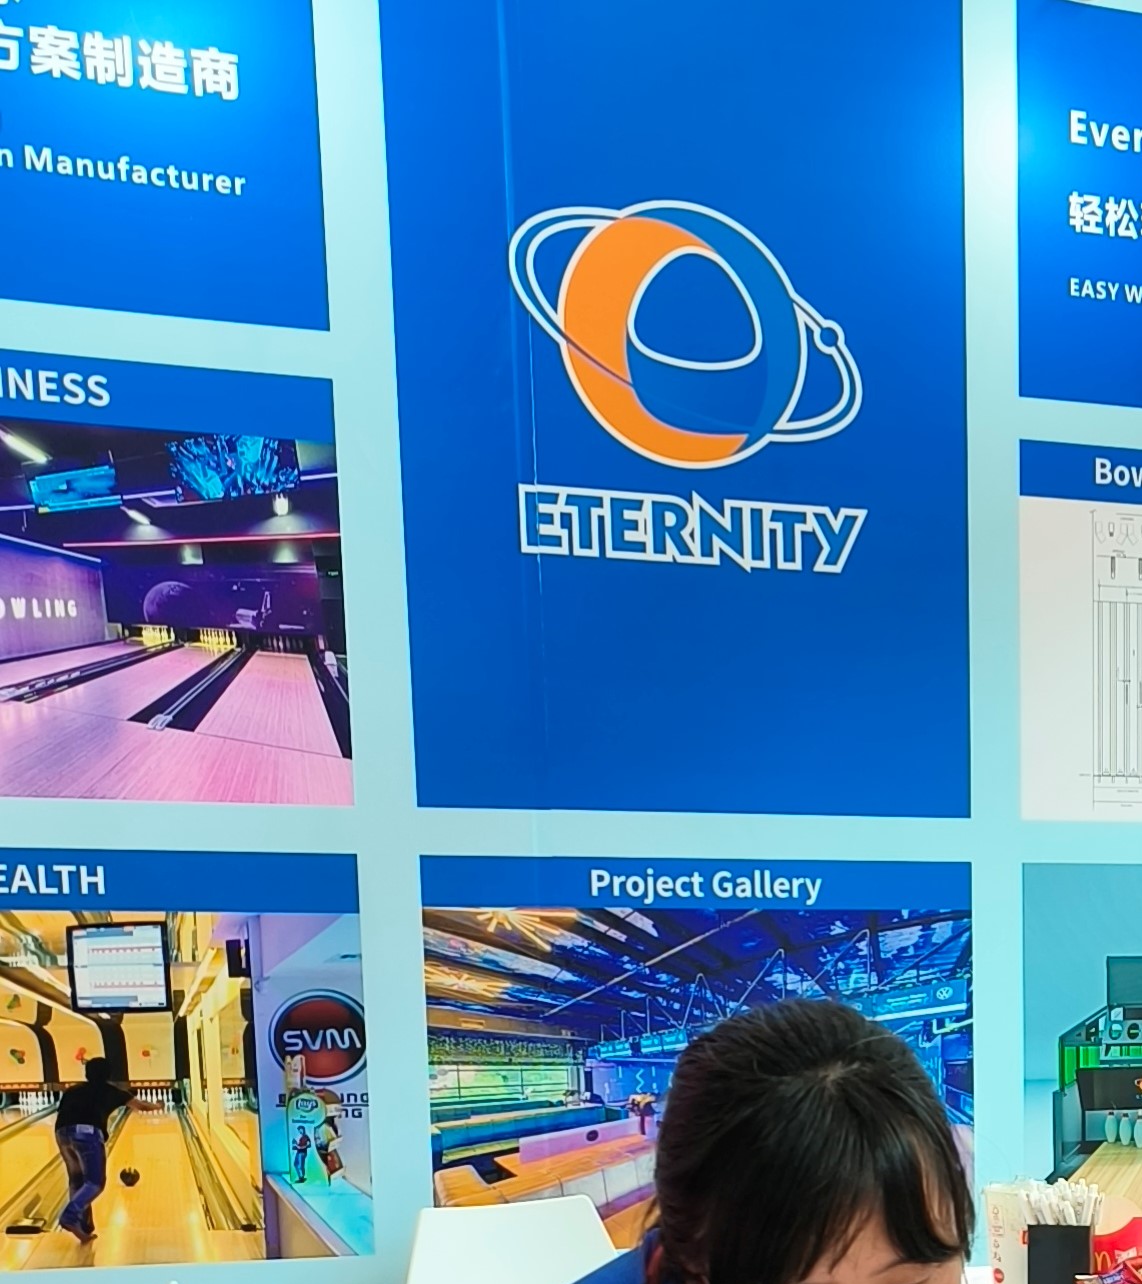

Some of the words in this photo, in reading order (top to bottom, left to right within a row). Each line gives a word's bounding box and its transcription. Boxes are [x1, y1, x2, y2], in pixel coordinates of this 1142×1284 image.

[24, 144, 247, 196] Manufacturer
[1069, 276, 1120, 301] EASY
[518, 483, 869, 574] ETERNITY
[589, 868, 704, 905] Project
[711, 870, 823, 905] Gallery
[282, 1027, 363, 1053] SVM
